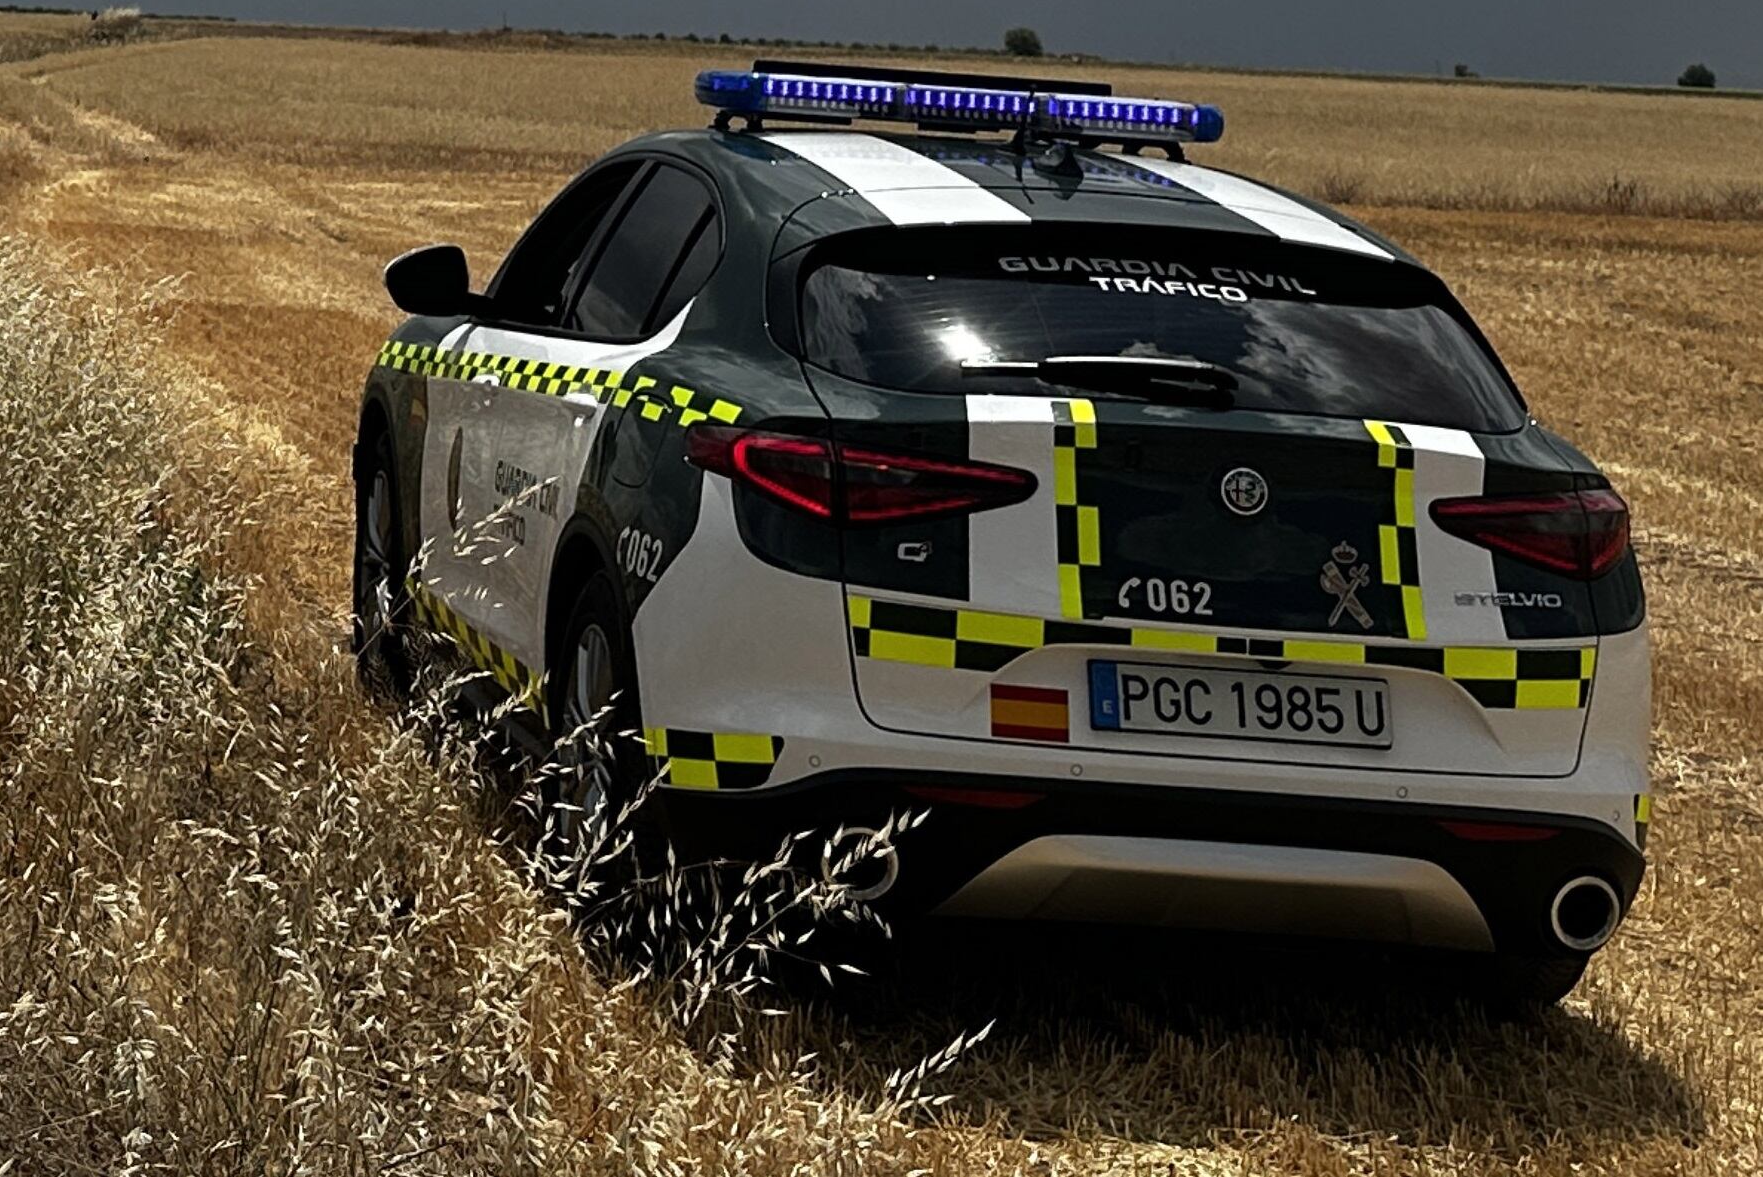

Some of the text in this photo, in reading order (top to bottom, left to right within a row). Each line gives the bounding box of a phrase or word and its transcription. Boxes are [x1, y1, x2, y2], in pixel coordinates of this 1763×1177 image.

[998, 256, 1317, 296] GUARDIA CIVIL
[1089, 276, 1248, 302] TRÁFICO
[626, 528, 663, 583] 062
[1146, 577, 1214, 616] 062
[1454, 591, 1562, 608] STELVIO
[1102, 700, 1114, 715] E
[1120, 673, 1386, 736] PGC 1985 U
